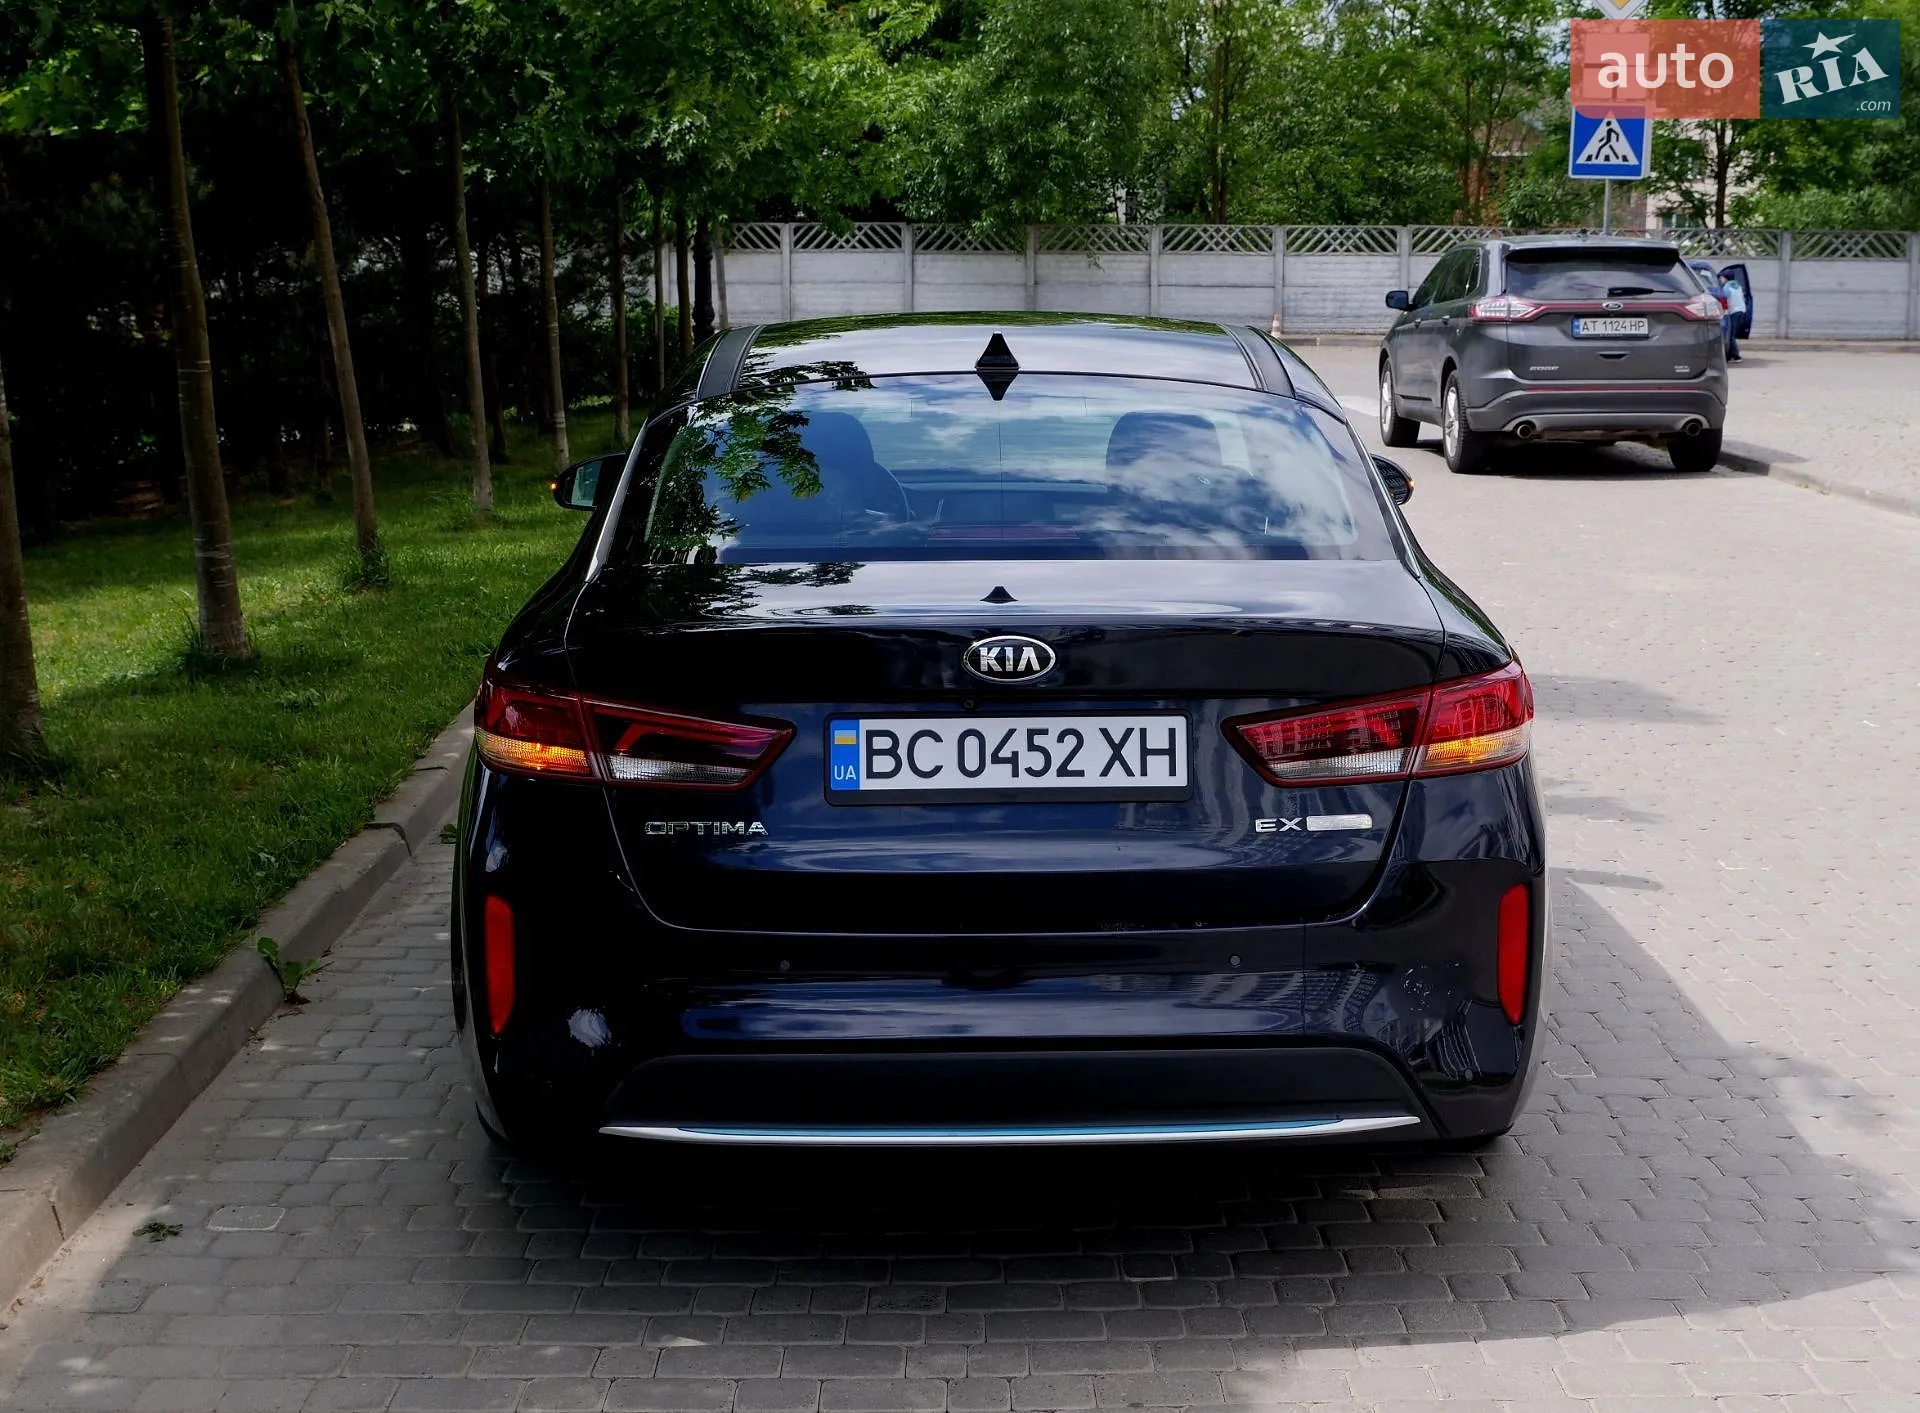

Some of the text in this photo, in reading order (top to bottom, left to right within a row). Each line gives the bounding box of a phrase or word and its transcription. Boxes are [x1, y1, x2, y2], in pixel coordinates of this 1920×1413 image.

[1582, 320, 1598, 332] AT
[1603, 320, 1627, 332] 1124
[1629, 320, 1645, 332] HP
[979, 647, 1041, 672] KIA
[865, 727, 1177, 780] BC 0452 XH
[834, 765, 857, 780] UA
[644, 821, 769, 835] OPTIMA
[1255, 817, 1303, 832] EX
